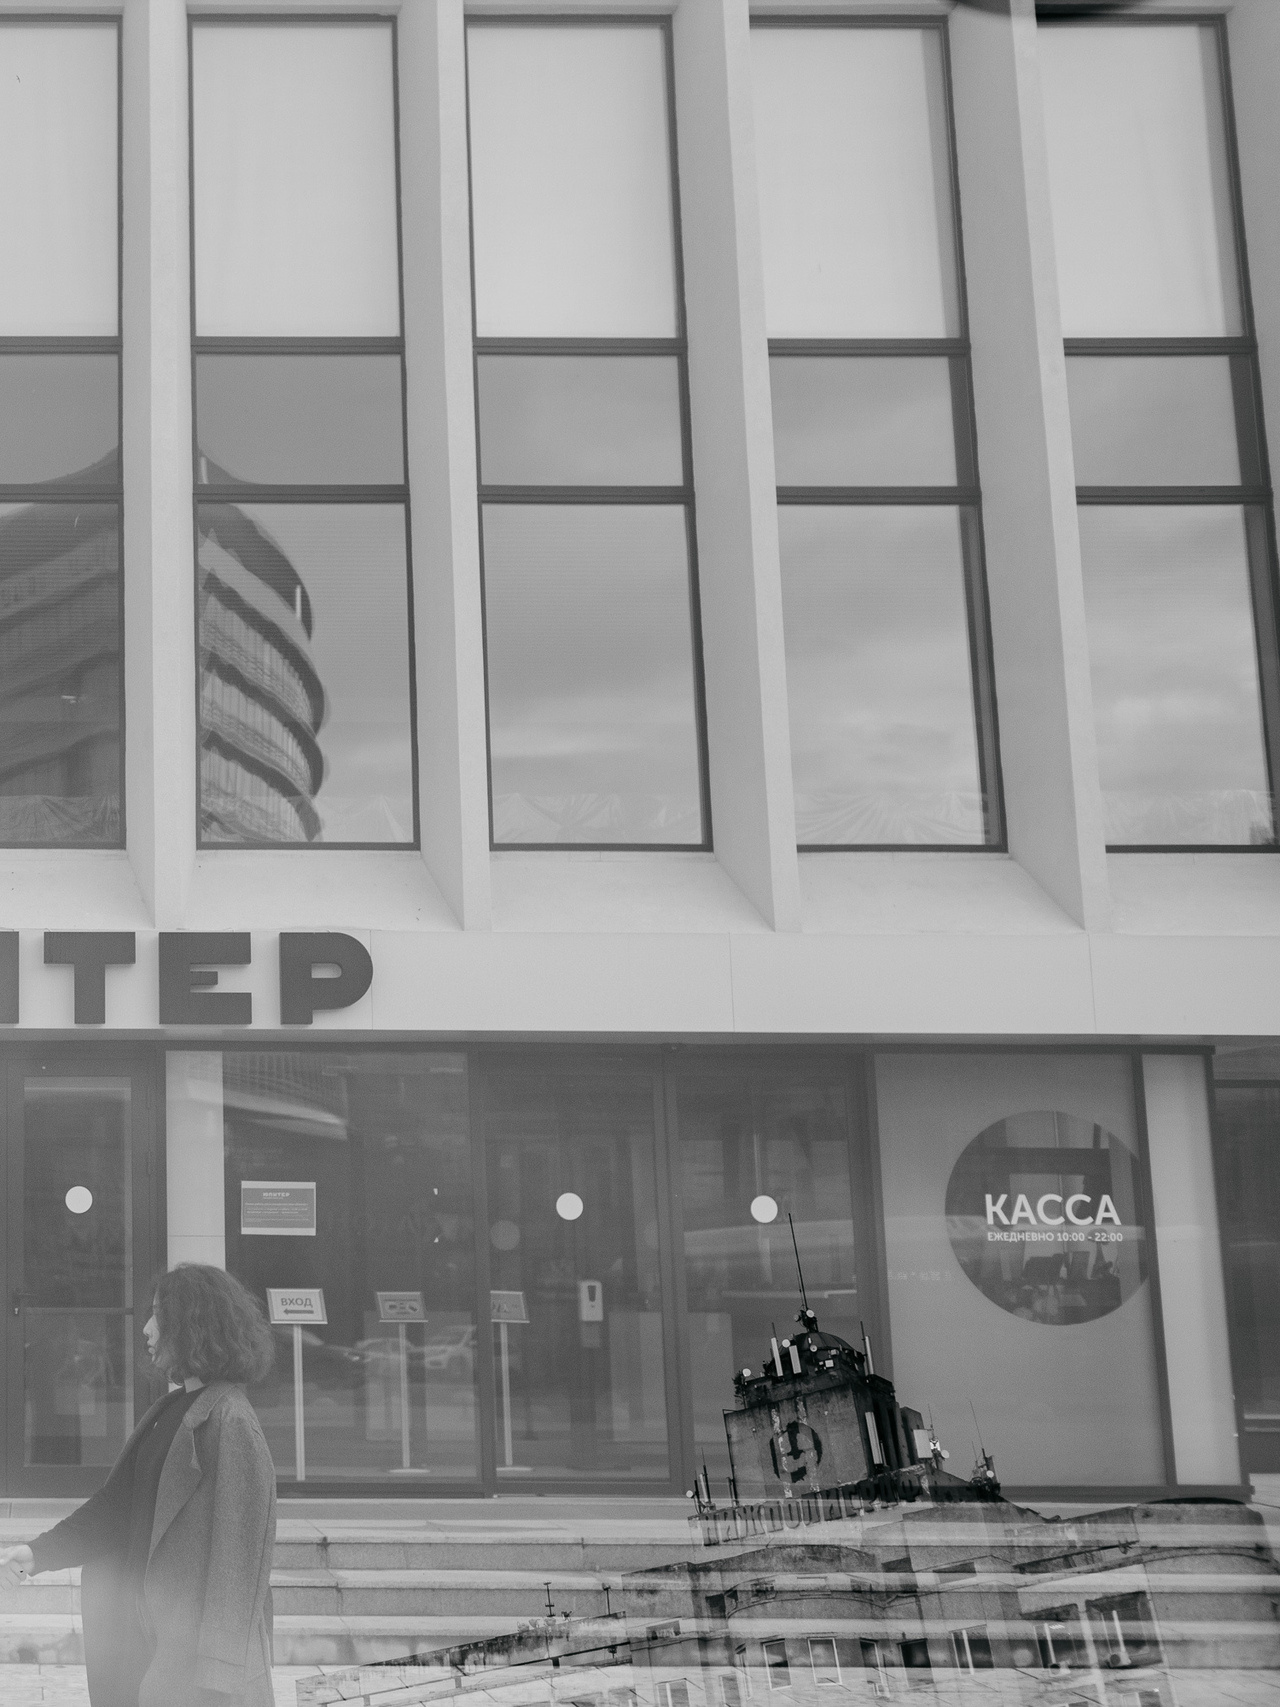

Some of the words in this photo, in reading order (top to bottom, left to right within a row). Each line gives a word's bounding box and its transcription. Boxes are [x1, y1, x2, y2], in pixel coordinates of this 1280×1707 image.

[985, 1194, 1122, 1226] КАССА
[987, 1232, 1055, 1243] ЕЖЕДНЕВНО
[1056, 1232, 1085, 1242] 10:00
[1094, 1232, 1123, 1242] 22:00
[280, 1298, 313, 1308] ВХОД
